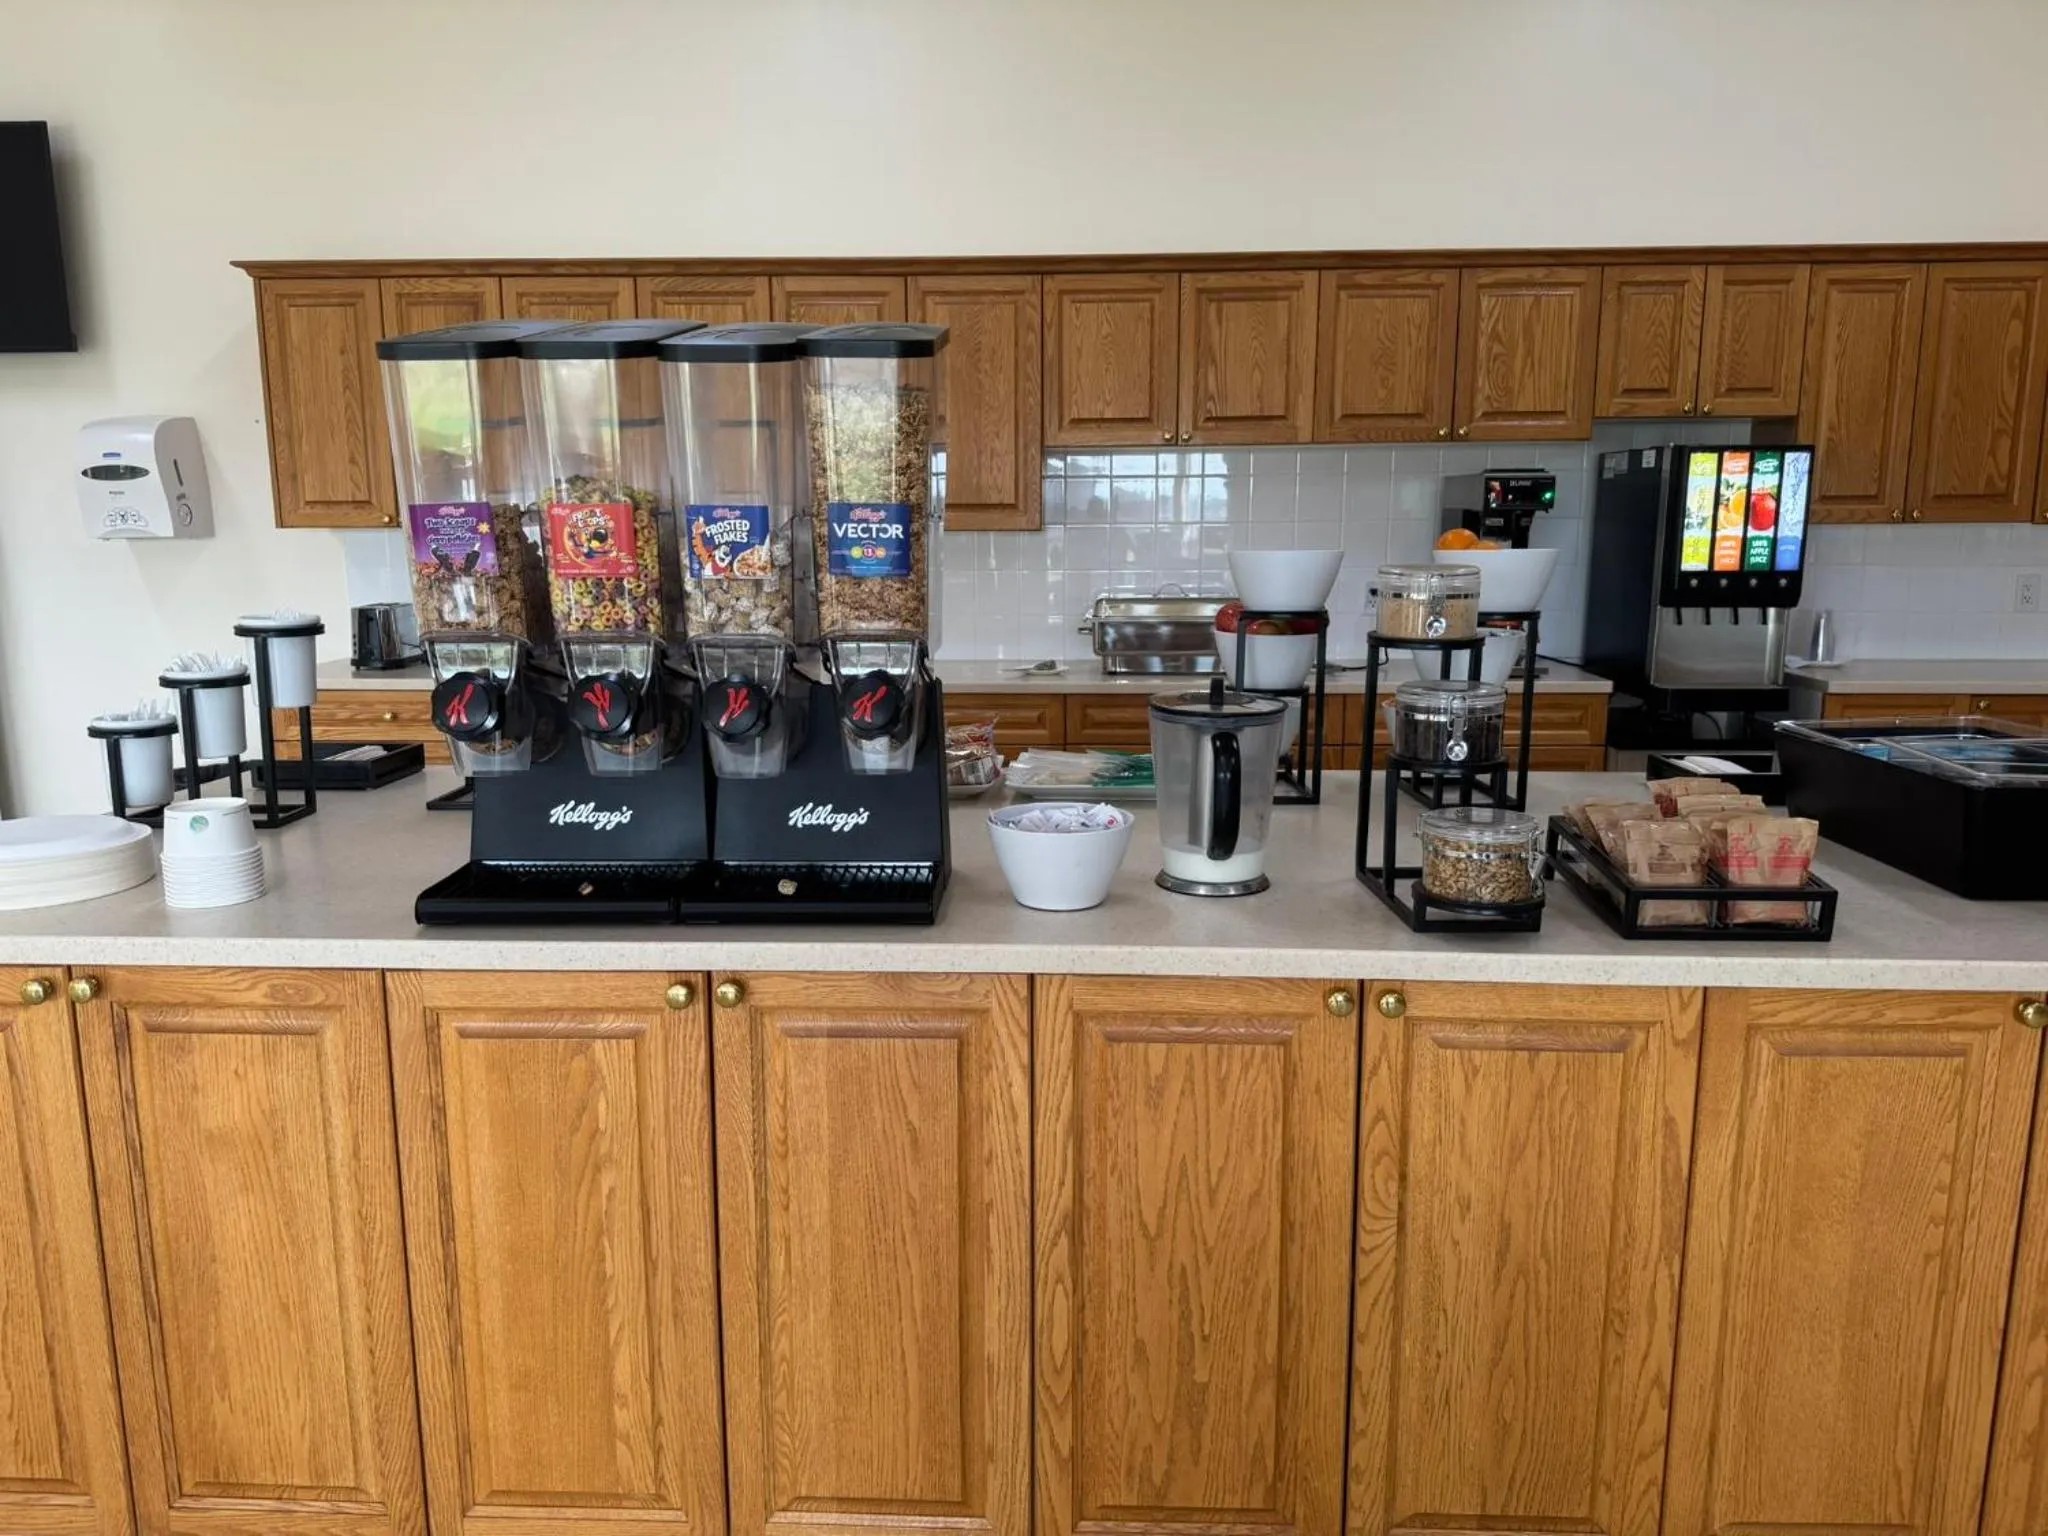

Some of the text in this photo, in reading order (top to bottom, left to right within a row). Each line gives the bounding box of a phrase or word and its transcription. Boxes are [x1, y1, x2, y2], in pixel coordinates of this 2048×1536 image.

[705, 519, 750, 538] FROSTED
[713, 530, 748, 545] FLAKES
[833, 523, 904, 538] VECTOR
[549, 800, 633, 830] Kellogg's
[788, 802, 870, 832] Kellogg's
